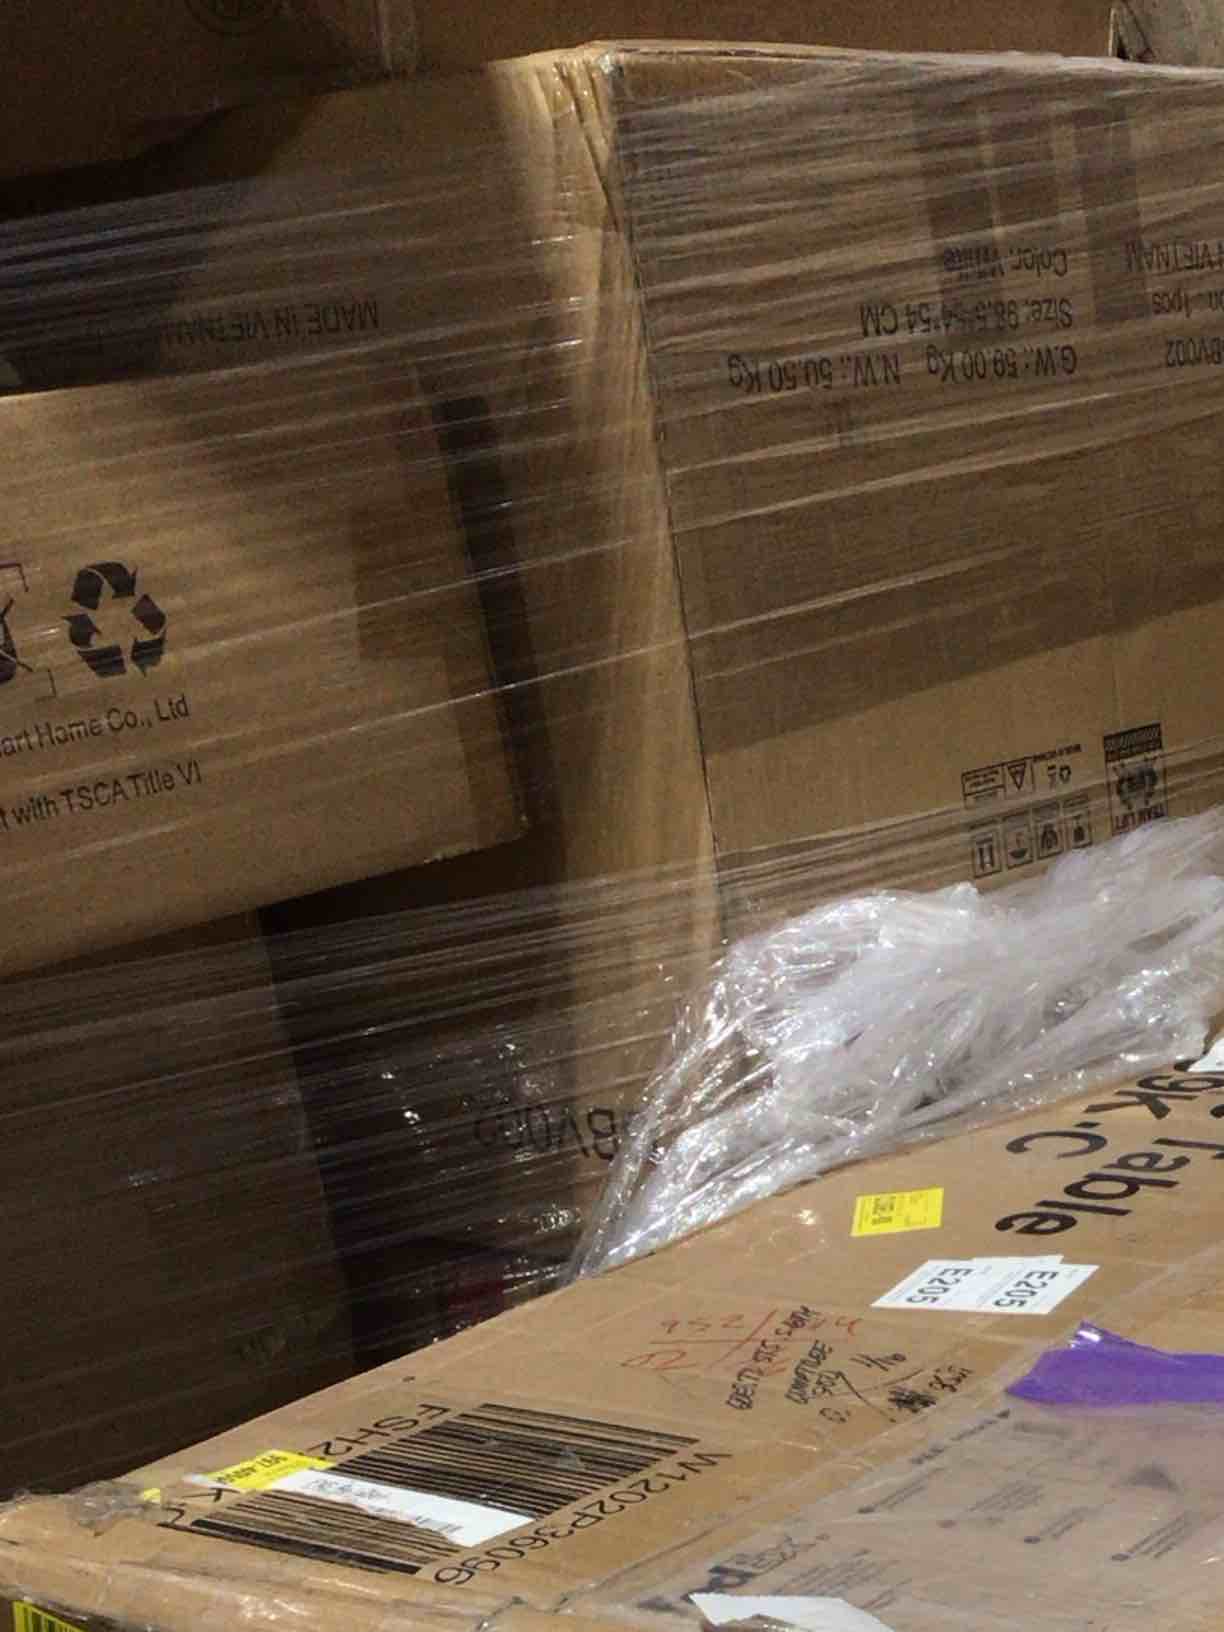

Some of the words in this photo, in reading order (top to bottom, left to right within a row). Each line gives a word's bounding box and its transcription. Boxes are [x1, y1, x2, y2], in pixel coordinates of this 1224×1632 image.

[854, 302, 898, 337] CM
[1026, 297, 1074, 330] Size:
[0, 728, 33, 760] art
[34, 718, 104, 748] Home
[153, 692, 192, 722] Ltd
[14, 792, 60, 826] with
[59, 776, 130, 814] TSCA
[126, 765, 176, 800] Title
[175, 757, 203, 787] VI
[905, 1267, 977, 1305] E205
[993, 1270, 1060, 1308] E205
